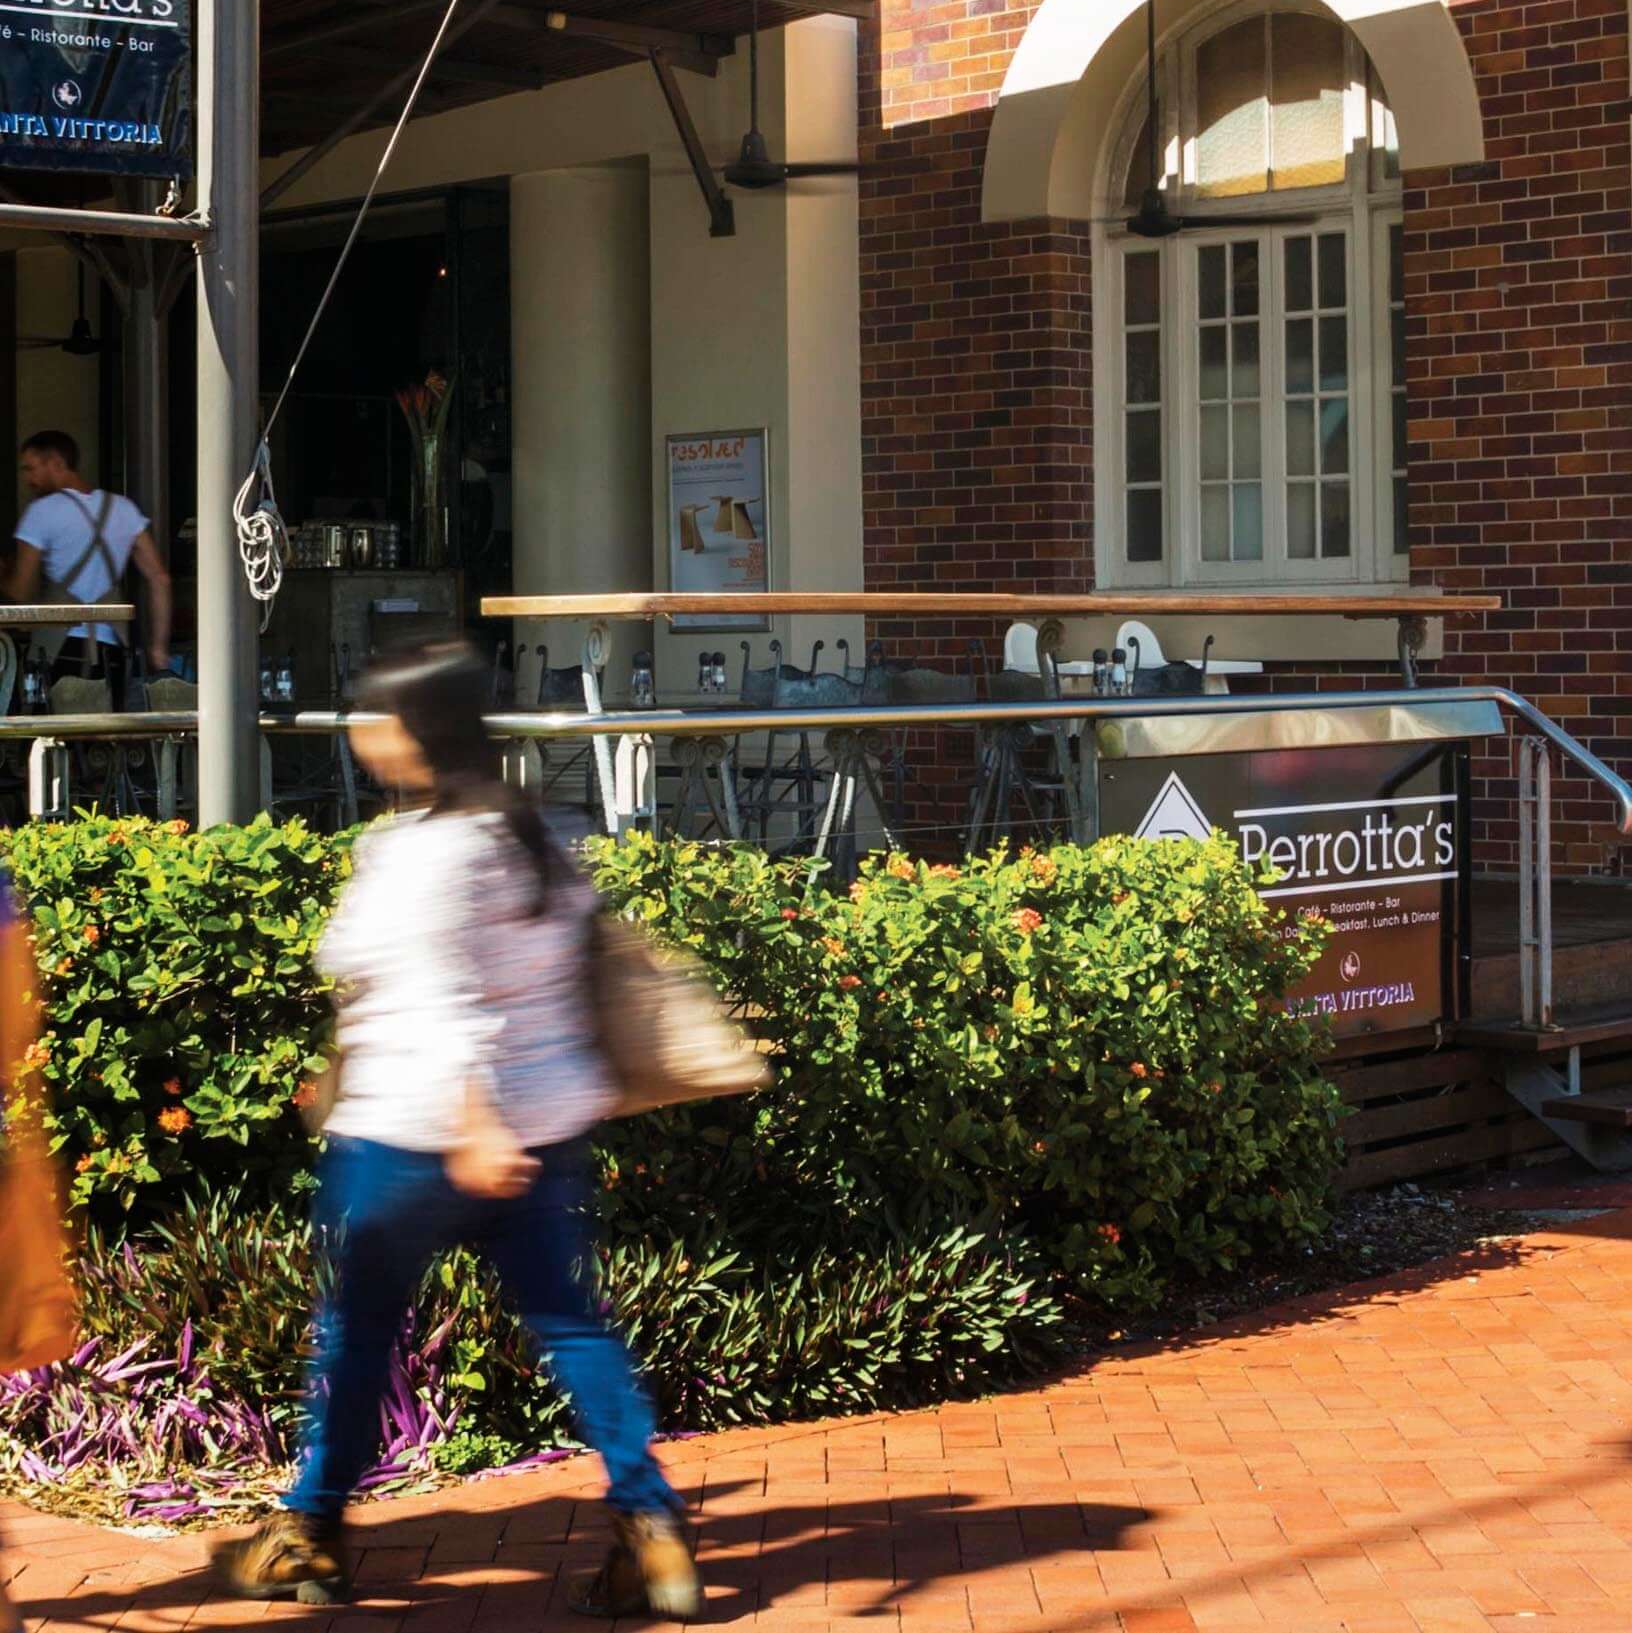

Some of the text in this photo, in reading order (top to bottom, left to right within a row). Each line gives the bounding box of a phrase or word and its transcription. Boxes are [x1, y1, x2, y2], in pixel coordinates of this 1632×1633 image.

[31, 28, 111, 48] Ristorante
[129, 38, 155, 52] Bar
[0, 113, 163, 144] NTA VITTORIA
[1238, 809, 1454, 882] Perrotta's
[1330, 899, 1376, 915] Ristorante
[1385, 896, 1401, 909] Bar
[1373, 913, 1400, 928] Lunch
[1411, 911, 1440, 924] Dinner
[1341, 982, 1414, 1011] VITTORIA
